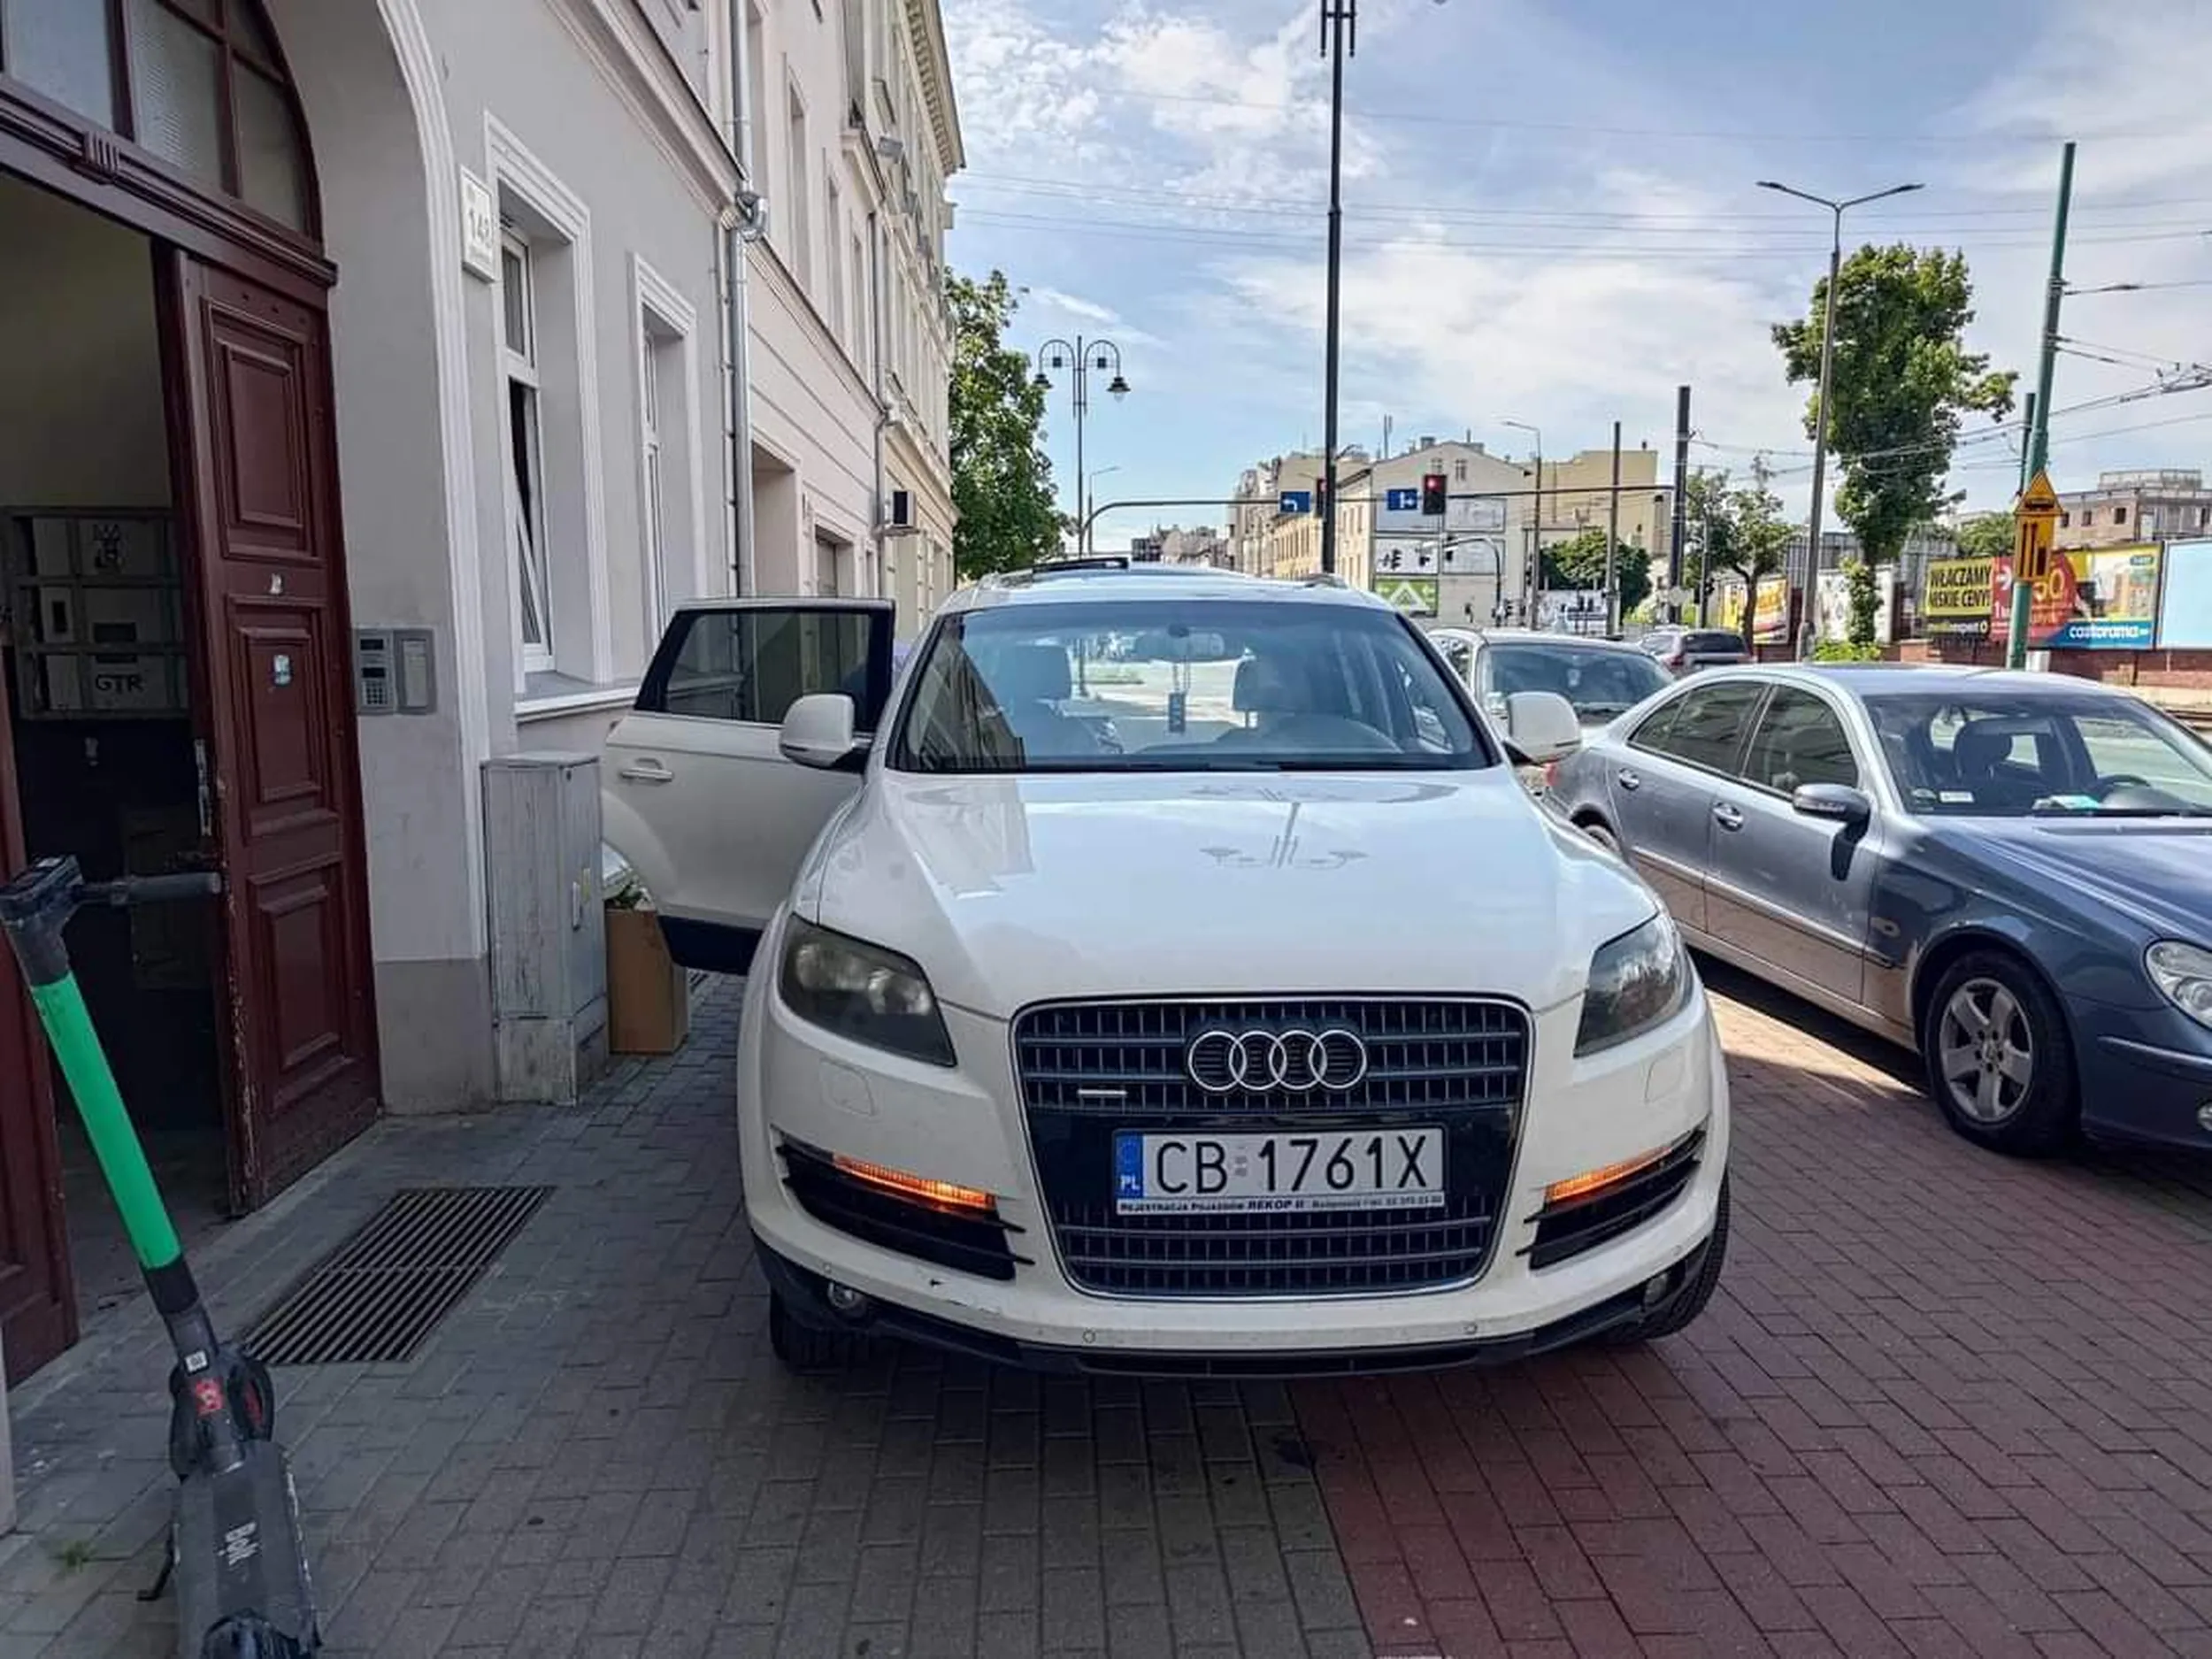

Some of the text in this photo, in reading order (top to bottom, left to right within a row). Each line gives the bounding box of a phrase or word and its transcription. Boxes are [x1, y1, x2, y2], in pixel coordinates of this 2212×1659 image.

[1119, 1175, 1141, 1191] PL
[1156, 1135, 1426, 1194] CB 1761X
